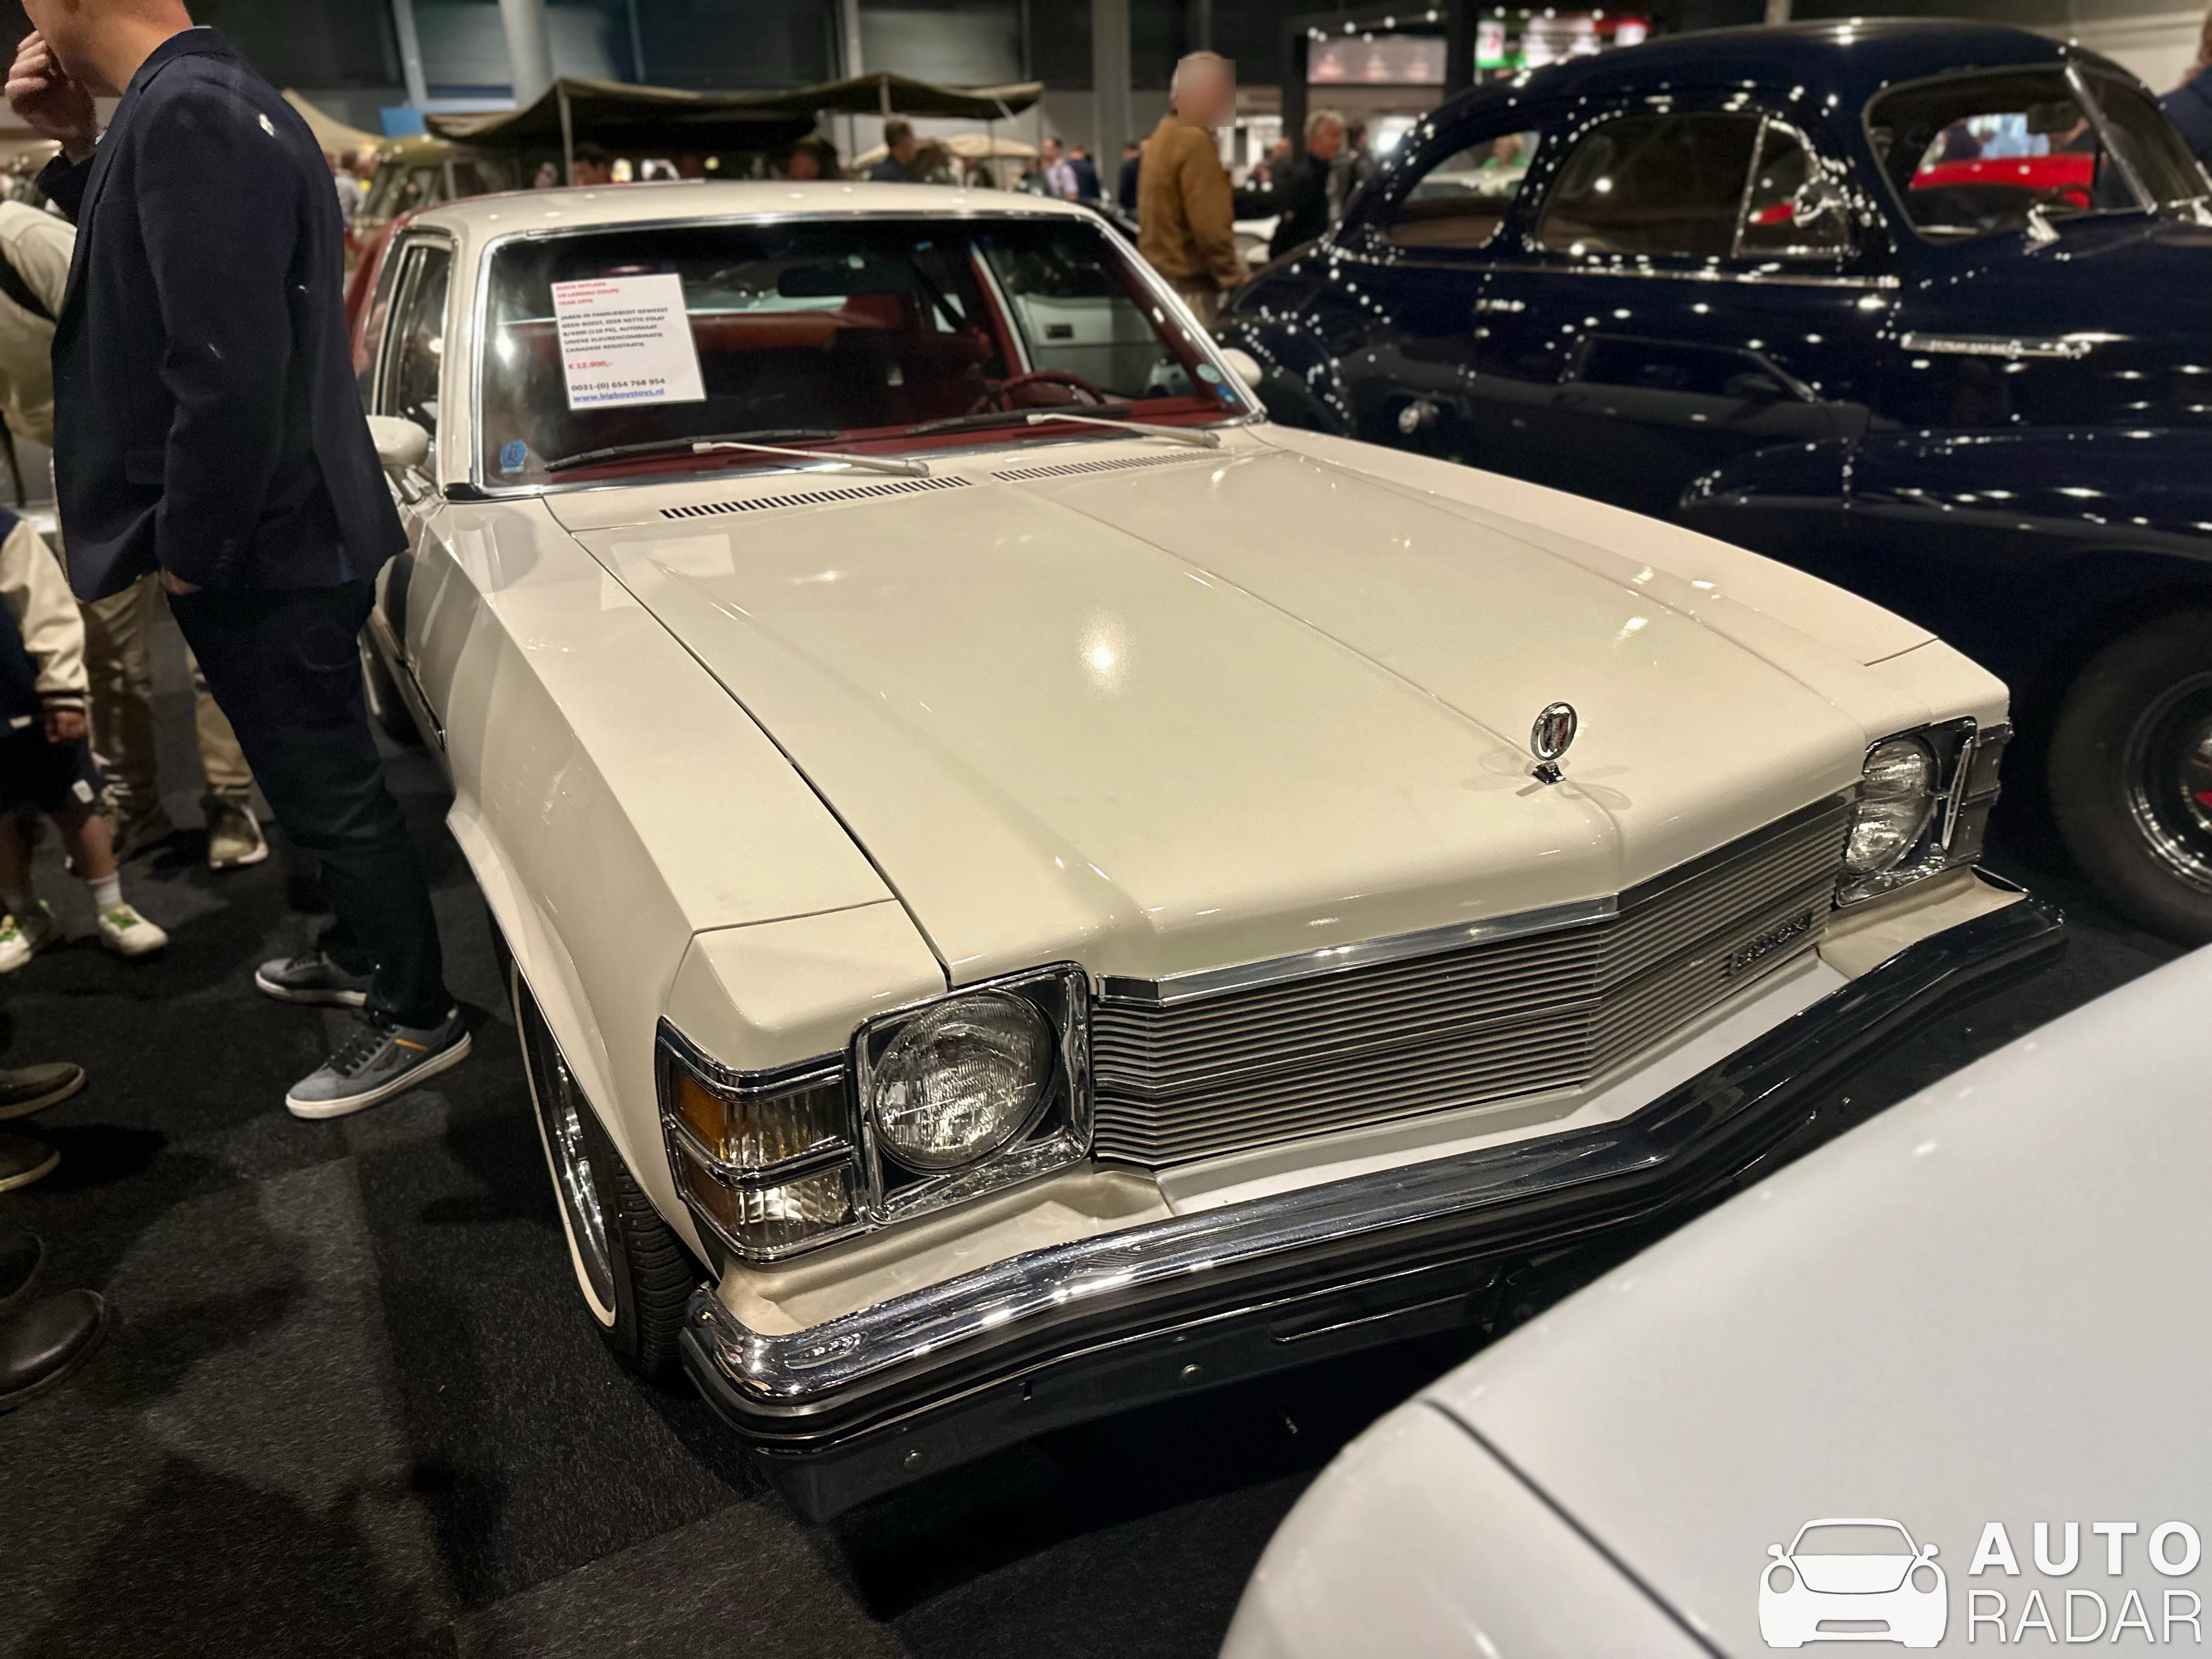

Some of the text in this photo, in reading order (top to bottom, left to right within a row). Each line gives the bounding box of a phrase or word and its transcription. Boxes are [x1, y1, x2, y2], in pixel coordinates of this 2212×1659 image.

[591, 332, 663, 342] KLEURENCOMBINATIE
[571, 383, 610, 391] 0031-(0)
[573, 388, 664, 403] www.bigboystoys.nl
